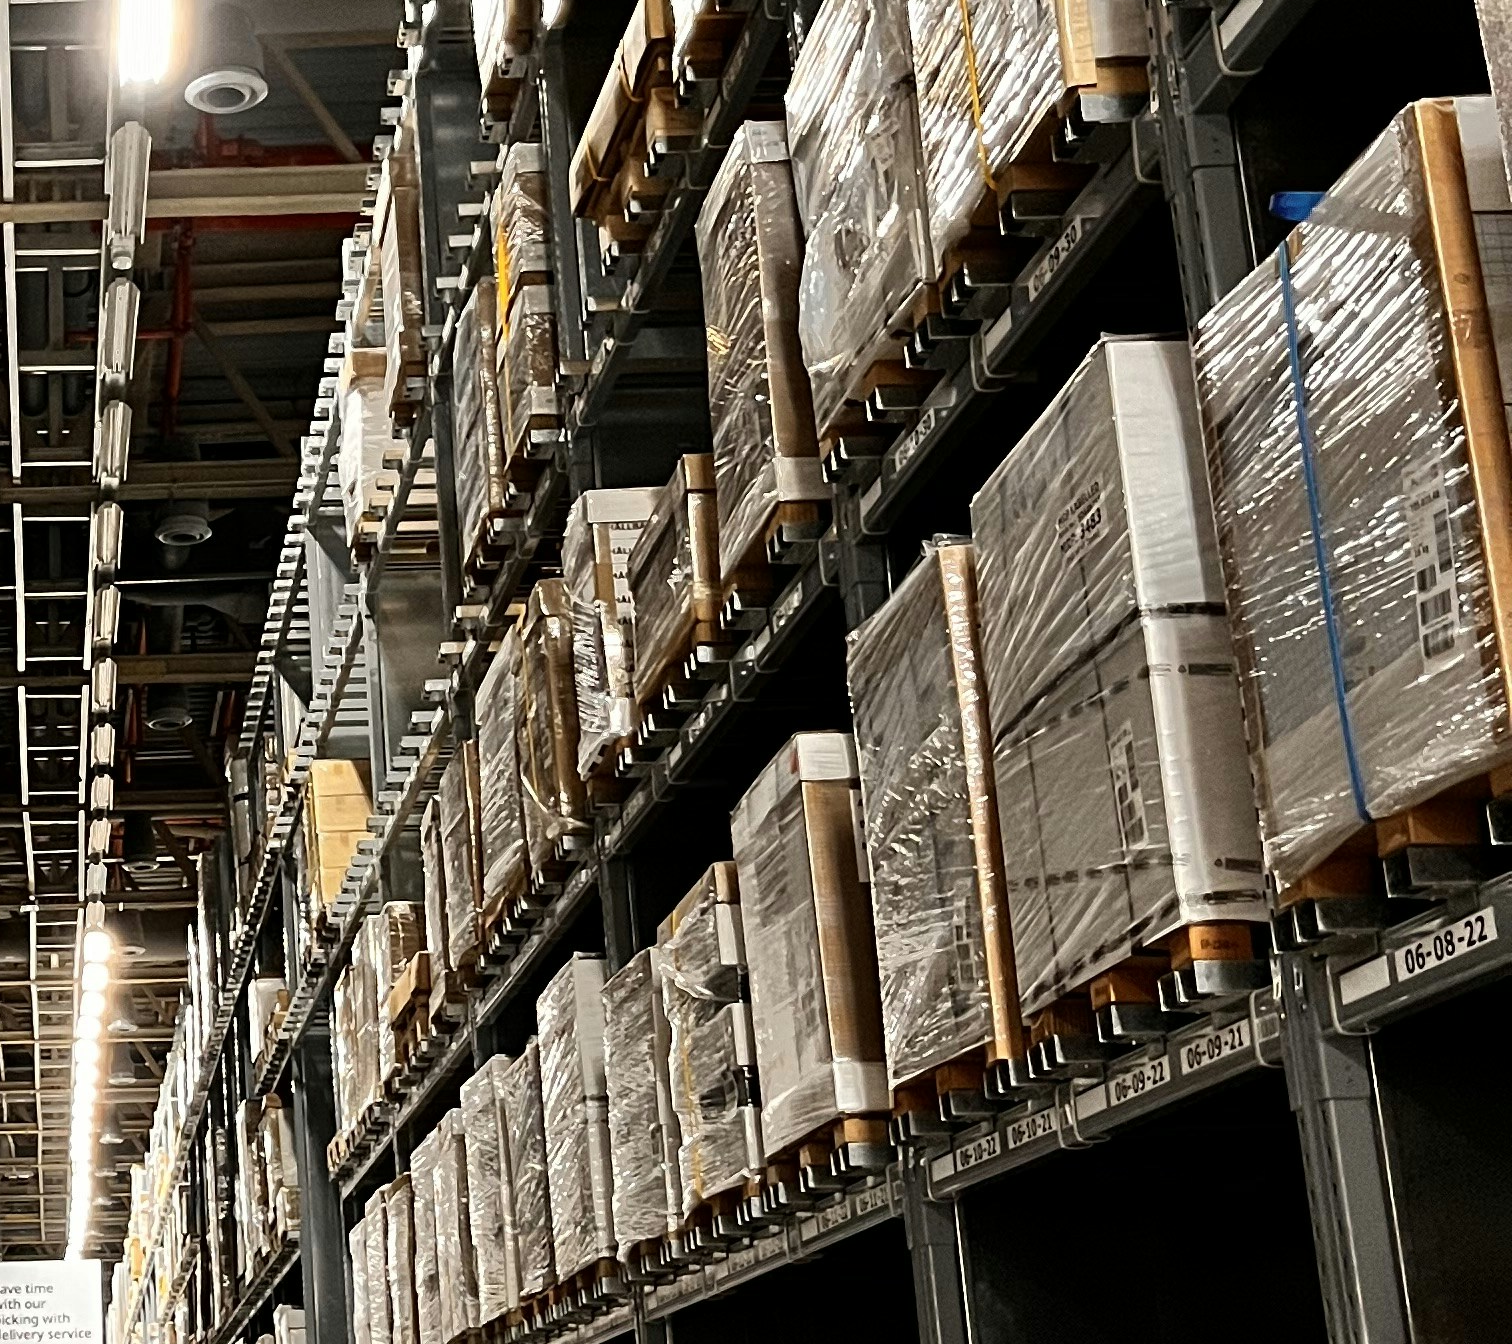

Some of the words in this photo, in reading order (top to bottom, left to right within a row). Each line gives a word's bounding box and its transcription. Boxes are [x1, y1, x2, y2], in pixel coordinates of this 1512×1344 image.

[1404, 914, 1488, 974] 06-08-22
[1186, 1027, 1245, 1070] 06-09-21
[1114, 1061, 1165, 1102] 06-09-22
[1011, 1111, 1052, 1146] 06-10-21
[959, 1136, 997, 1168] 06-10-22
[24, 1299, 47, 1310] our
[25, 1283, 54, 1295] time
[42, 1313, 71, 1325] with
[48, 1328, 92, 1340] service
